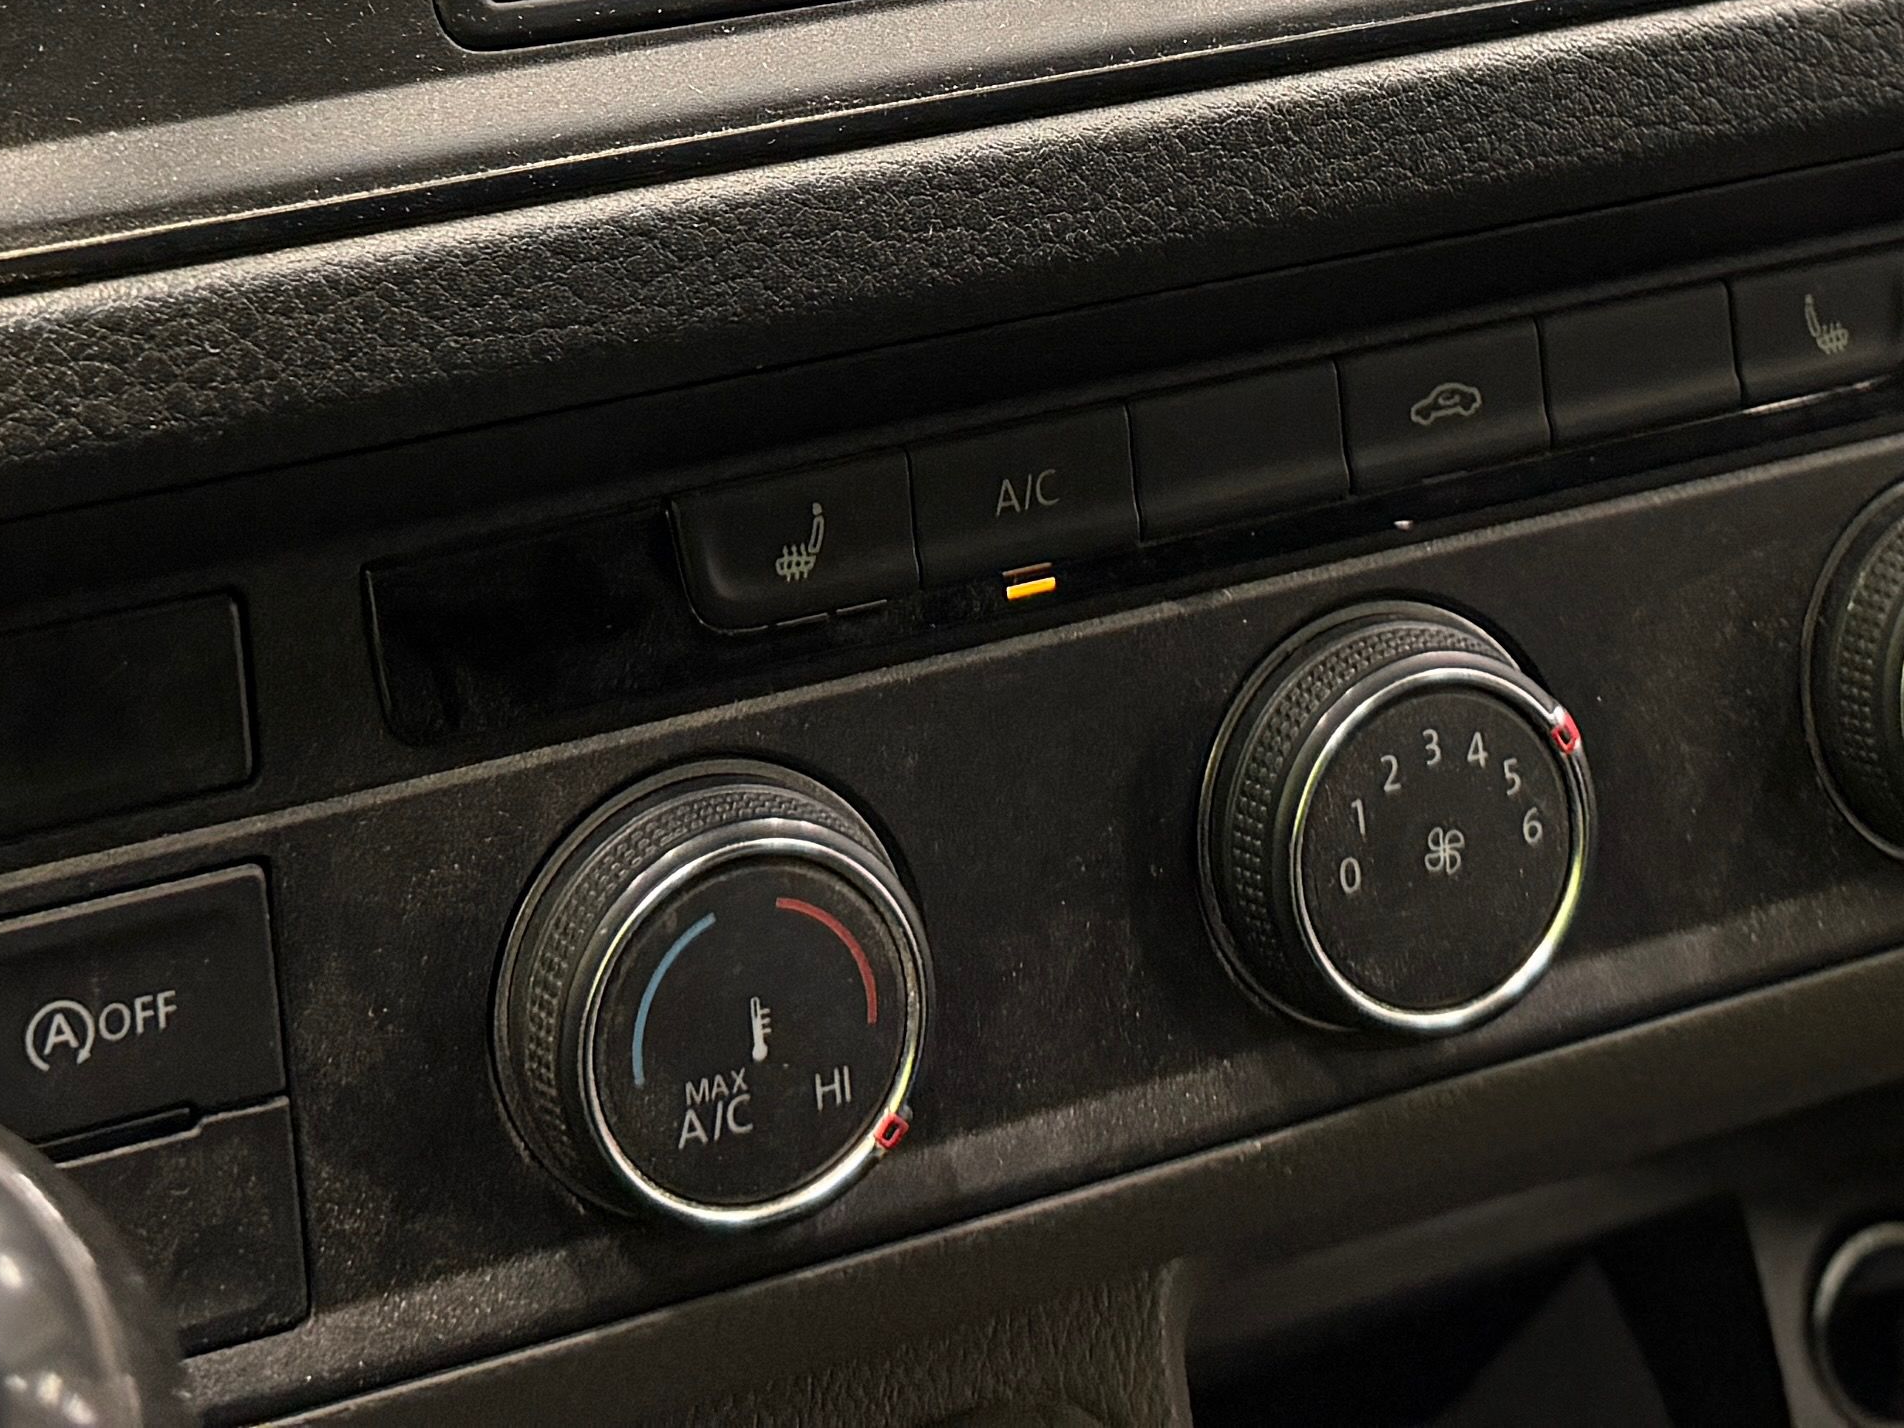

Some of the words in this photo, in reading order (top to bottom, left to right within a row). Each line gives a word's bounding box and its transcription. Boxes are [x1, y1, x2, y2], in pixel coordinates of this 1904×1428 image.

[996, 469, 1061, 518] A/C
[1421, 728, 1443, 767] 3
[1466, 732, 1489, 769] 4
[1380, 754, 1402, 793] 2
[1502, 757, 1522, 796] 5
[1350, 798, 1367, 837] 1
[1523, 807, 1544, 844] 6
[1339, 857, 1362, 895] 0
[98, 990, 178, 1042] OFF
[684, 1067, 750, 1106] MAX
[814, 1065, 853, 1112] HI
[677, 1095, 754, 1150] A/C
